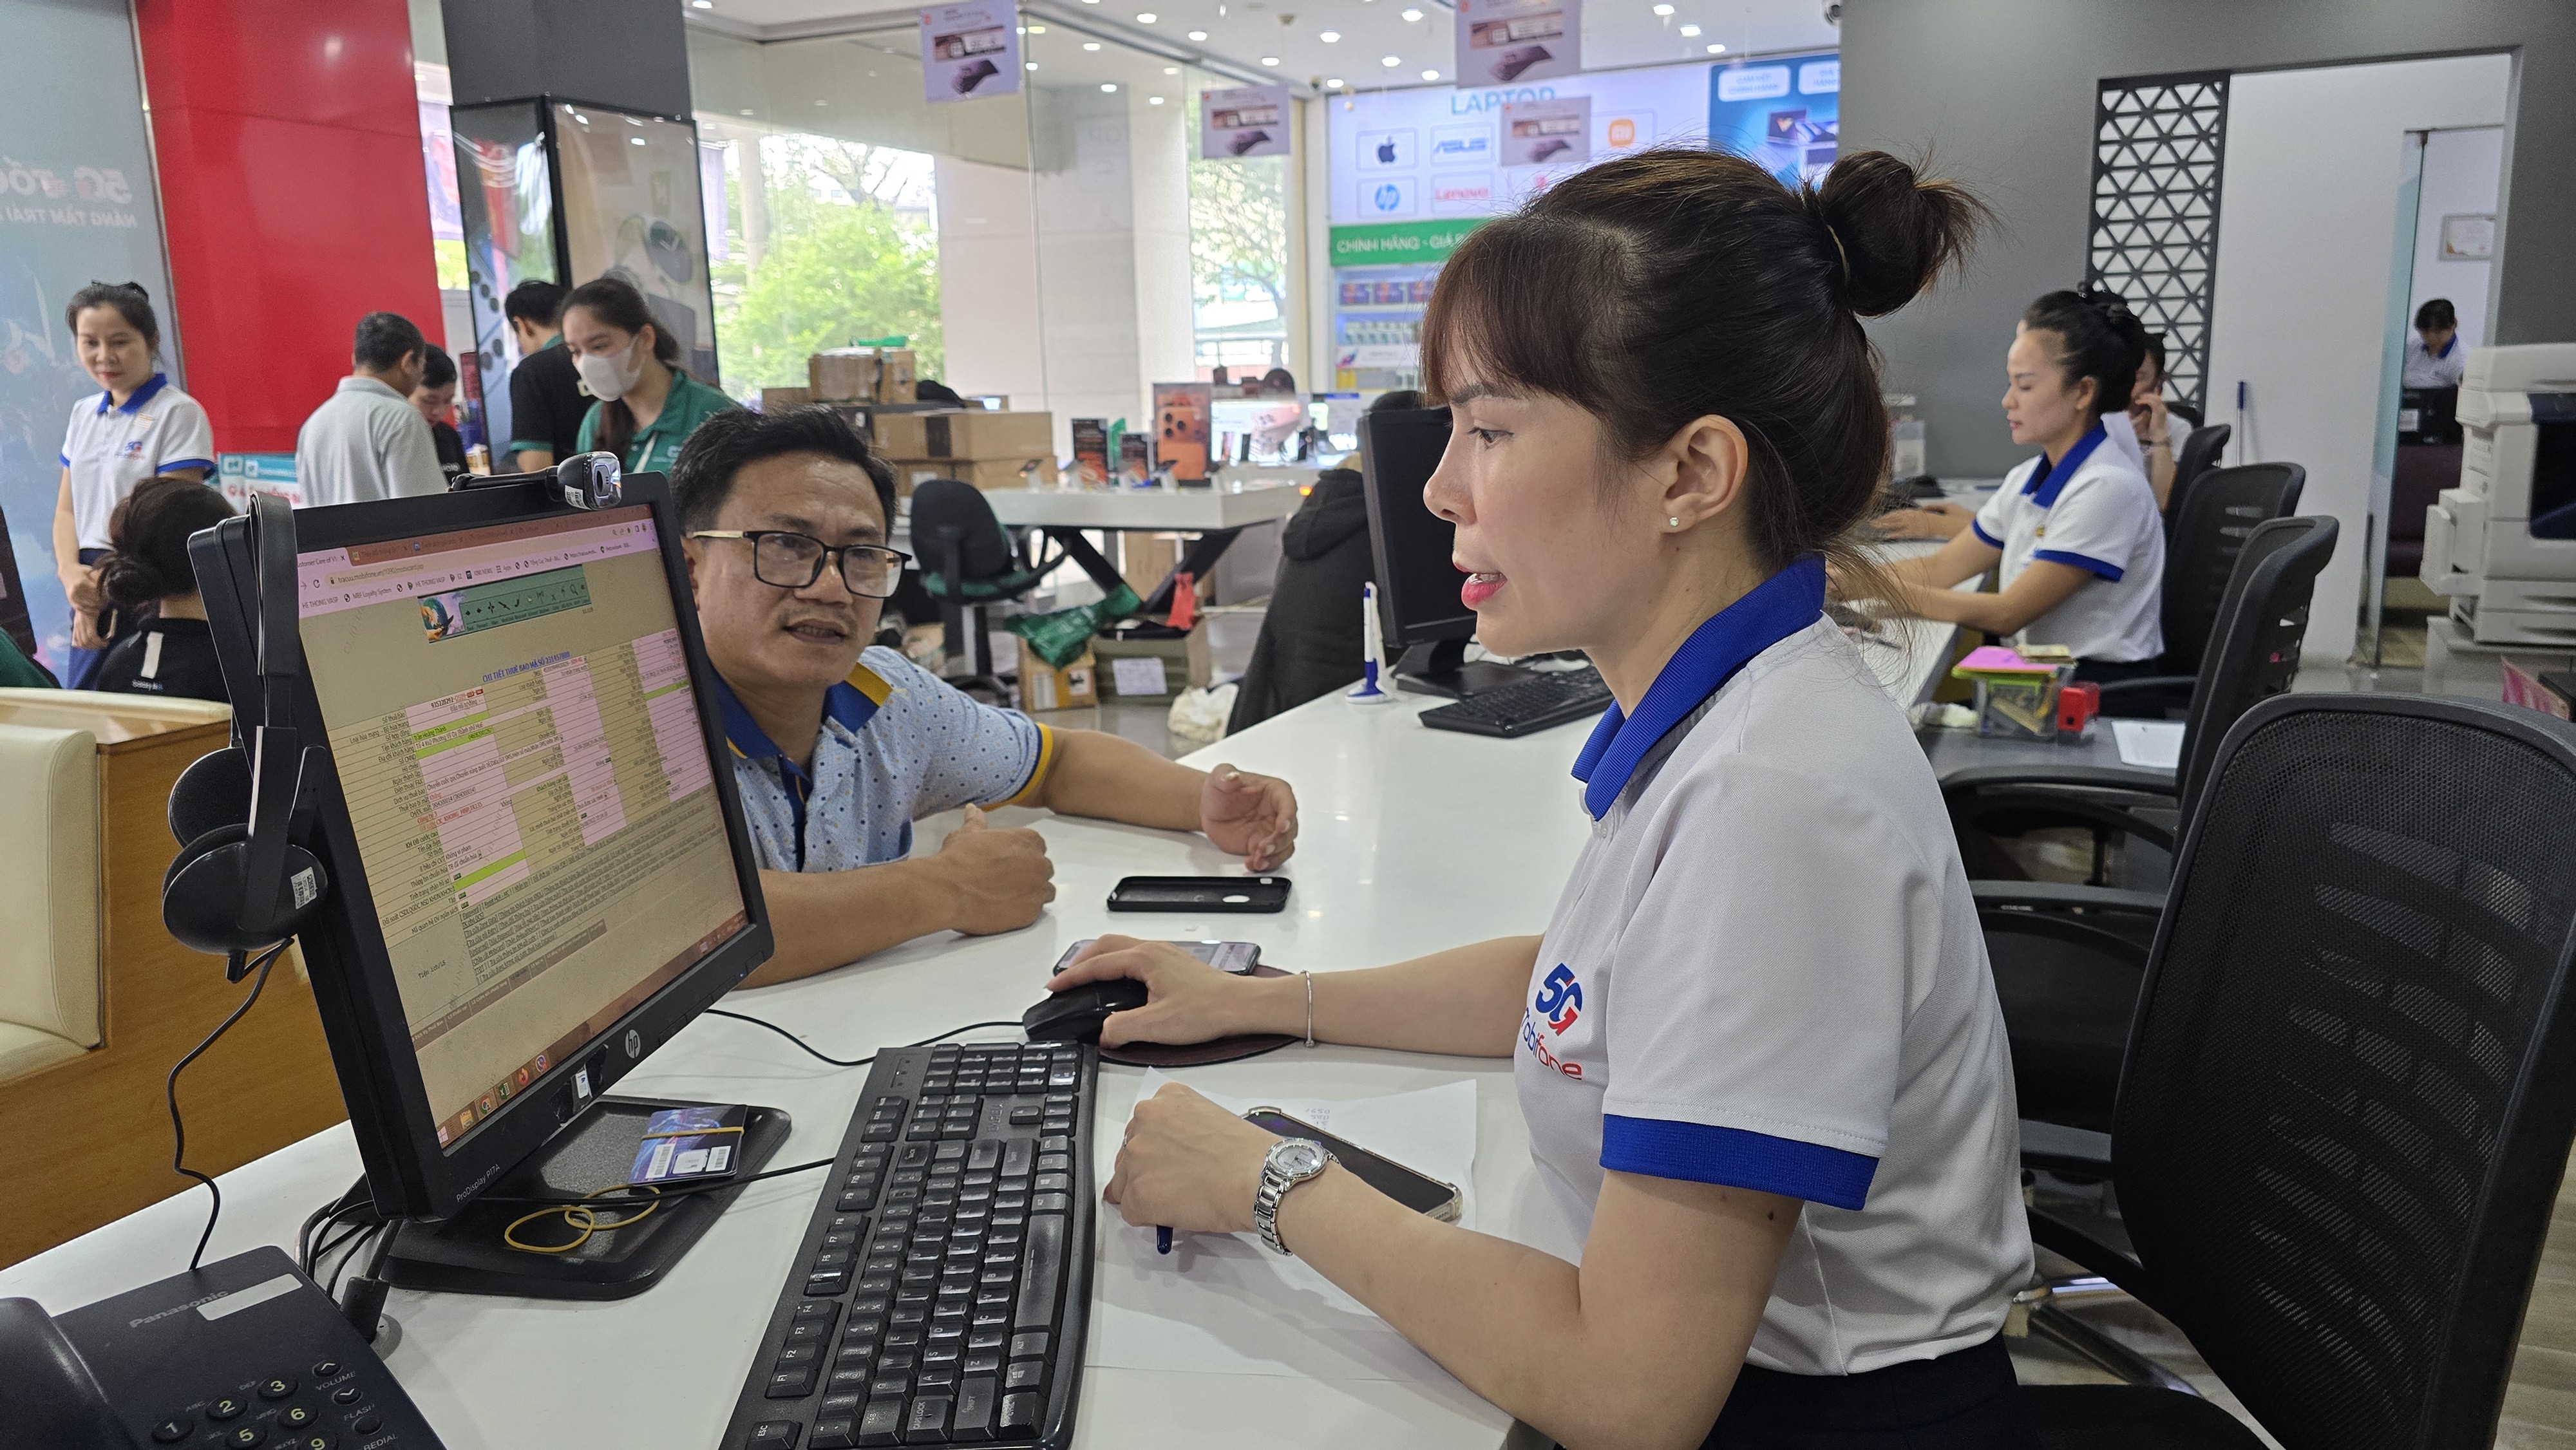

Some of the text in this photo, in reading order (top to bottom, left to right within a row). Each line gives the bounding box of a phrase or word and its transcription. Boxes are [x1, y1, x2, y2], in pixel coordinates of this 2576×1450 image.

[519, 663, 529, 672] BAO
[1535, 962, 1583, 1037] 5G
[625, 1030, 641, 1059] hp
[457, 1163, 500, 1202] ProDisplay P17A
[129, 1291, 229, 1328] Panasonic
[802, 1304, 813, 1313] F4
[795, 1326, 805, 1335] F3
[786, 1350, 797, 1359] F2
[882, 1358, 894, 1366] W
[270, 1380, 286, 1392] 3
[316, 1371, 356, 1391] VOLUME
[218, 1400, 236, 1413] 2
[967, 1395, 976, 1411] SHIFT
[290, 1408, 305, 1420] 6
[344, 1403, 375, 1422] FLASH
[166, 1422, 178, 1433] 1
[757, 1424, 768, 1436] ESC
[239, 1428, 254, 1442] 5
[311, 1438, 325, 1450] 9
[363, 1433, 398, 1450] REDIAL
